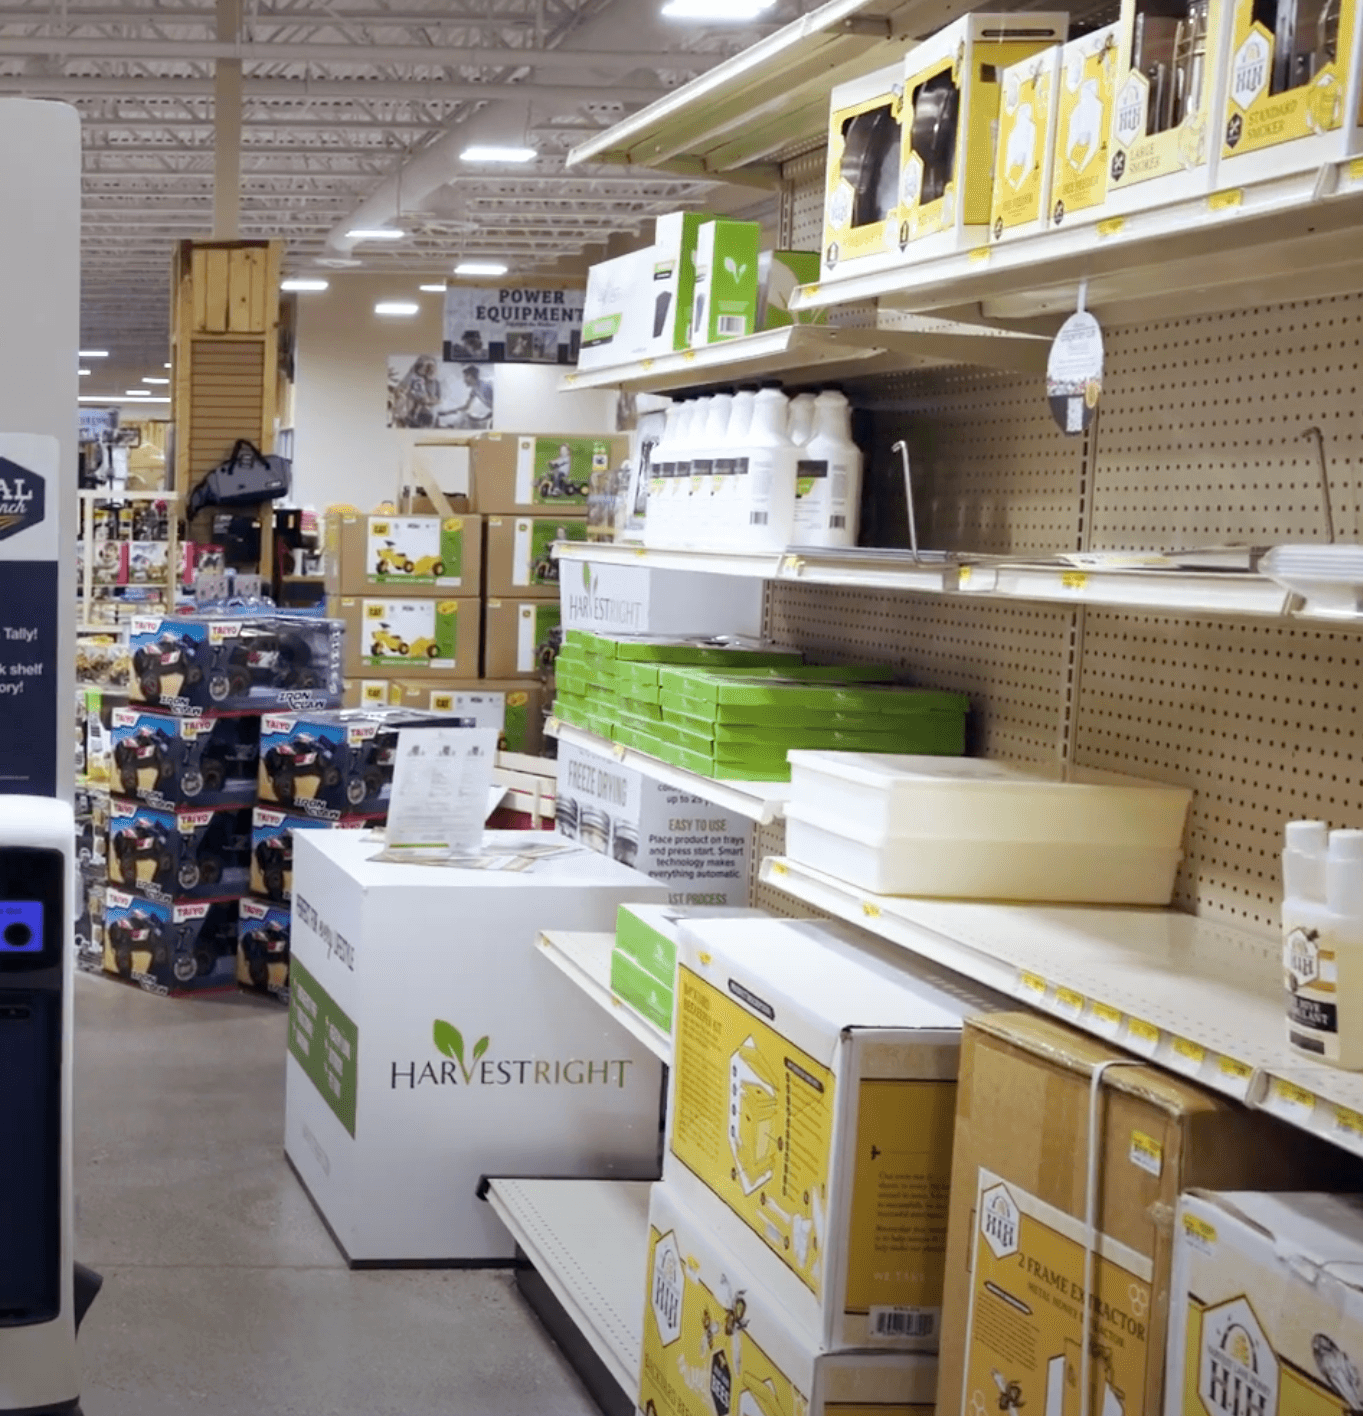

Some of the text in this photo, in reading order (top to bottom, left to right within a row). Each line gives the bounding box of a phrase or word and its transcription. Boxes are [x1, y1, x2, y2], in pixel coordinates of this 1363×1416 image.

[498, 289, 565, 304] POWER
[475, 305, 585, 323] EQUIPMENT
[569, 594, 642, 629] HARVESTRIGHT
[3, 627, 38, 643] Tally!
[9, 663, 43, 675] shelf
[279, 691, 313, 702] IRON
[666, 796, 677, 806] up
[678, 794, 689, 803] to
[668, 818, 728, 832] EASY TO USE
[649, 834, 745, 846] Place product on trays
[649, 847, 665, 856] and
[667, 848, 692, 858] press
[718, 846, 744, 856] Smart
[656, 857, 736, 869] technology makes
[648, 869, 742, 880] everything automatic.
[688, 892, 728, 905] PROCESS
[390, 1059, 634, 1090] HARVESTRIGHT
[1018, 1253, 1026, 1269] 2
[1027, 1257, 1070, 1297] FRAME
[1071, 1282, 1146, 1343] EXRACTOR
